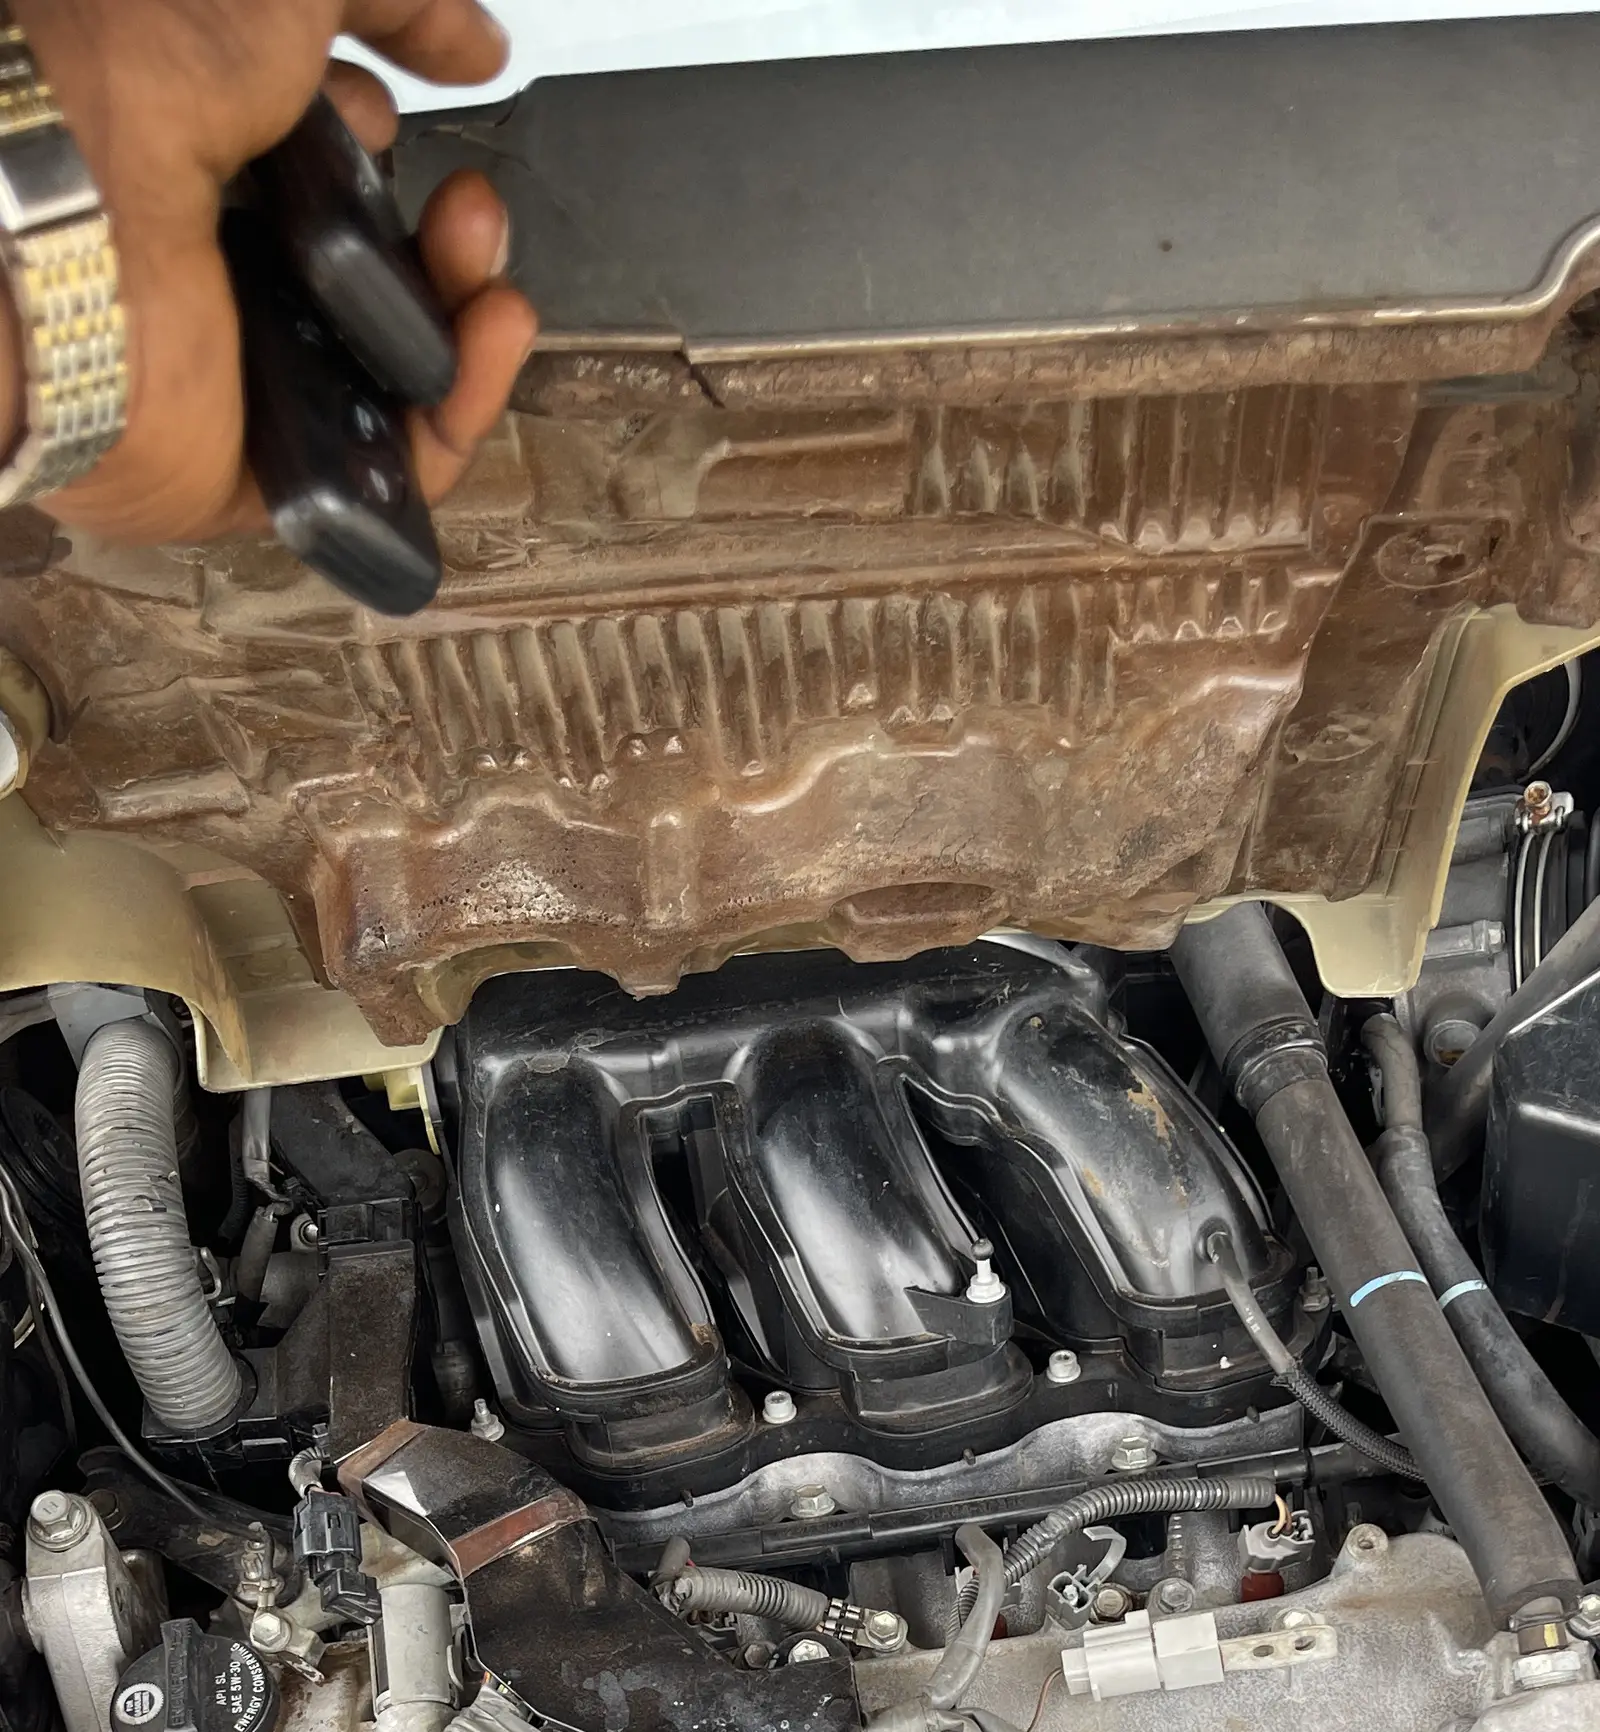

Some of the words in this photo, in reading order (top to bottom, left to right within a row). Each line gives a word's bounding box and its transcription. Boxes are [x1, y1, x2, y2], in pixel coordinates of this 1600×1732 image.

[215, 1672, 226, 1684] SL
[230, 1643, 264, 1693] CONSERVING
[230, 1661, 242, 1692] 5W-30
[215, 1689, 227, 1705] API
[231, 1694, 242, 1713] SAE
[234, 1695, 262, 1732] ENERGY
